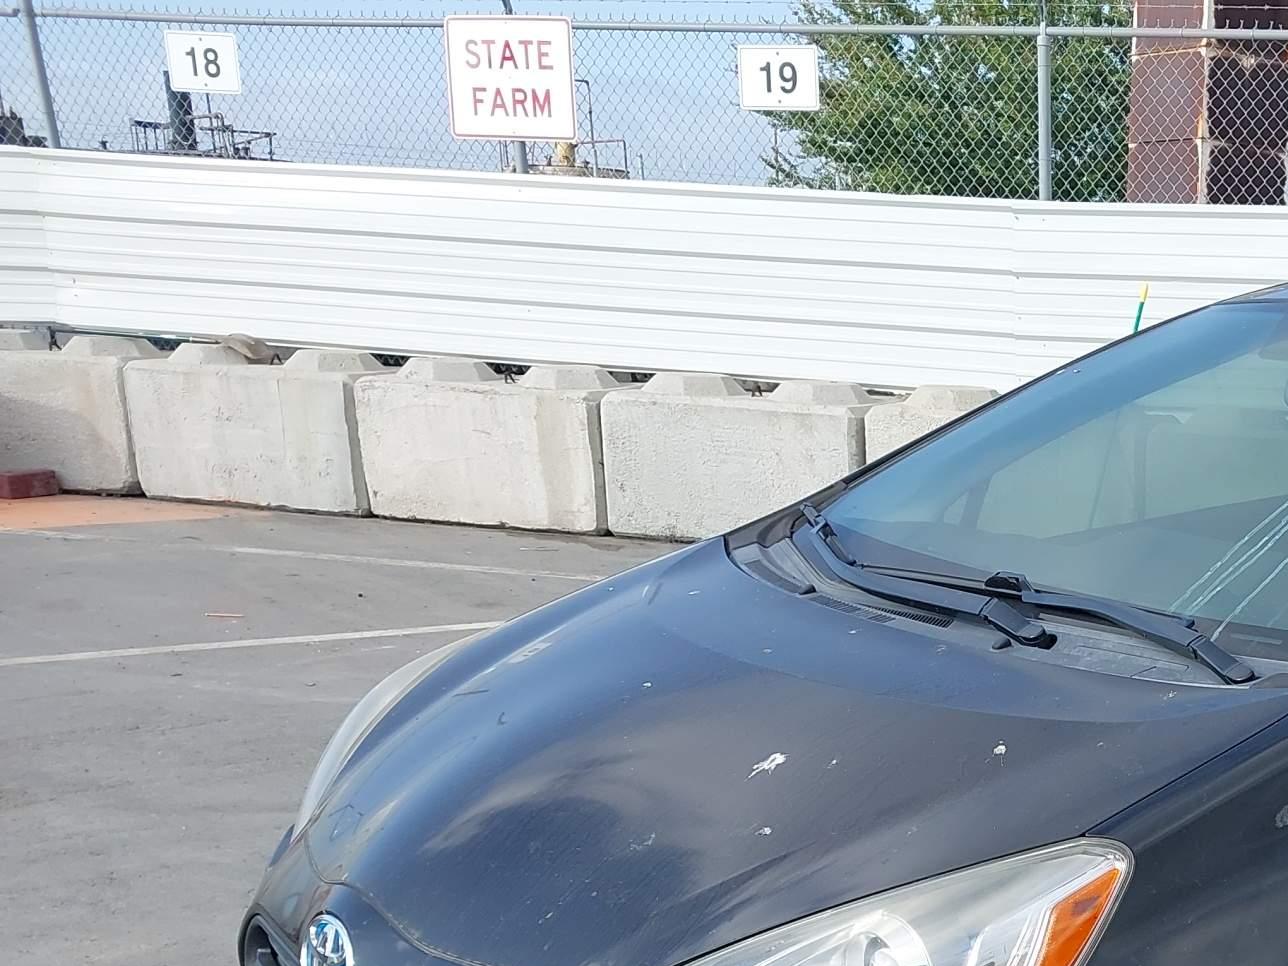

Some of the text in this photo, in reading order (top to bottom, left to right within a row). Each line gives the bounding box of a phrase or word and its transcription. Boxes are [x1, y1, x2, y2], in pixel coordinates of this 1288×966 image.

[185, 46, 221, 78] 18
[465, 39, 554, 70] STATE
[759, 61, 798, 94] 19
[472, 87, 552, 118] FARM
